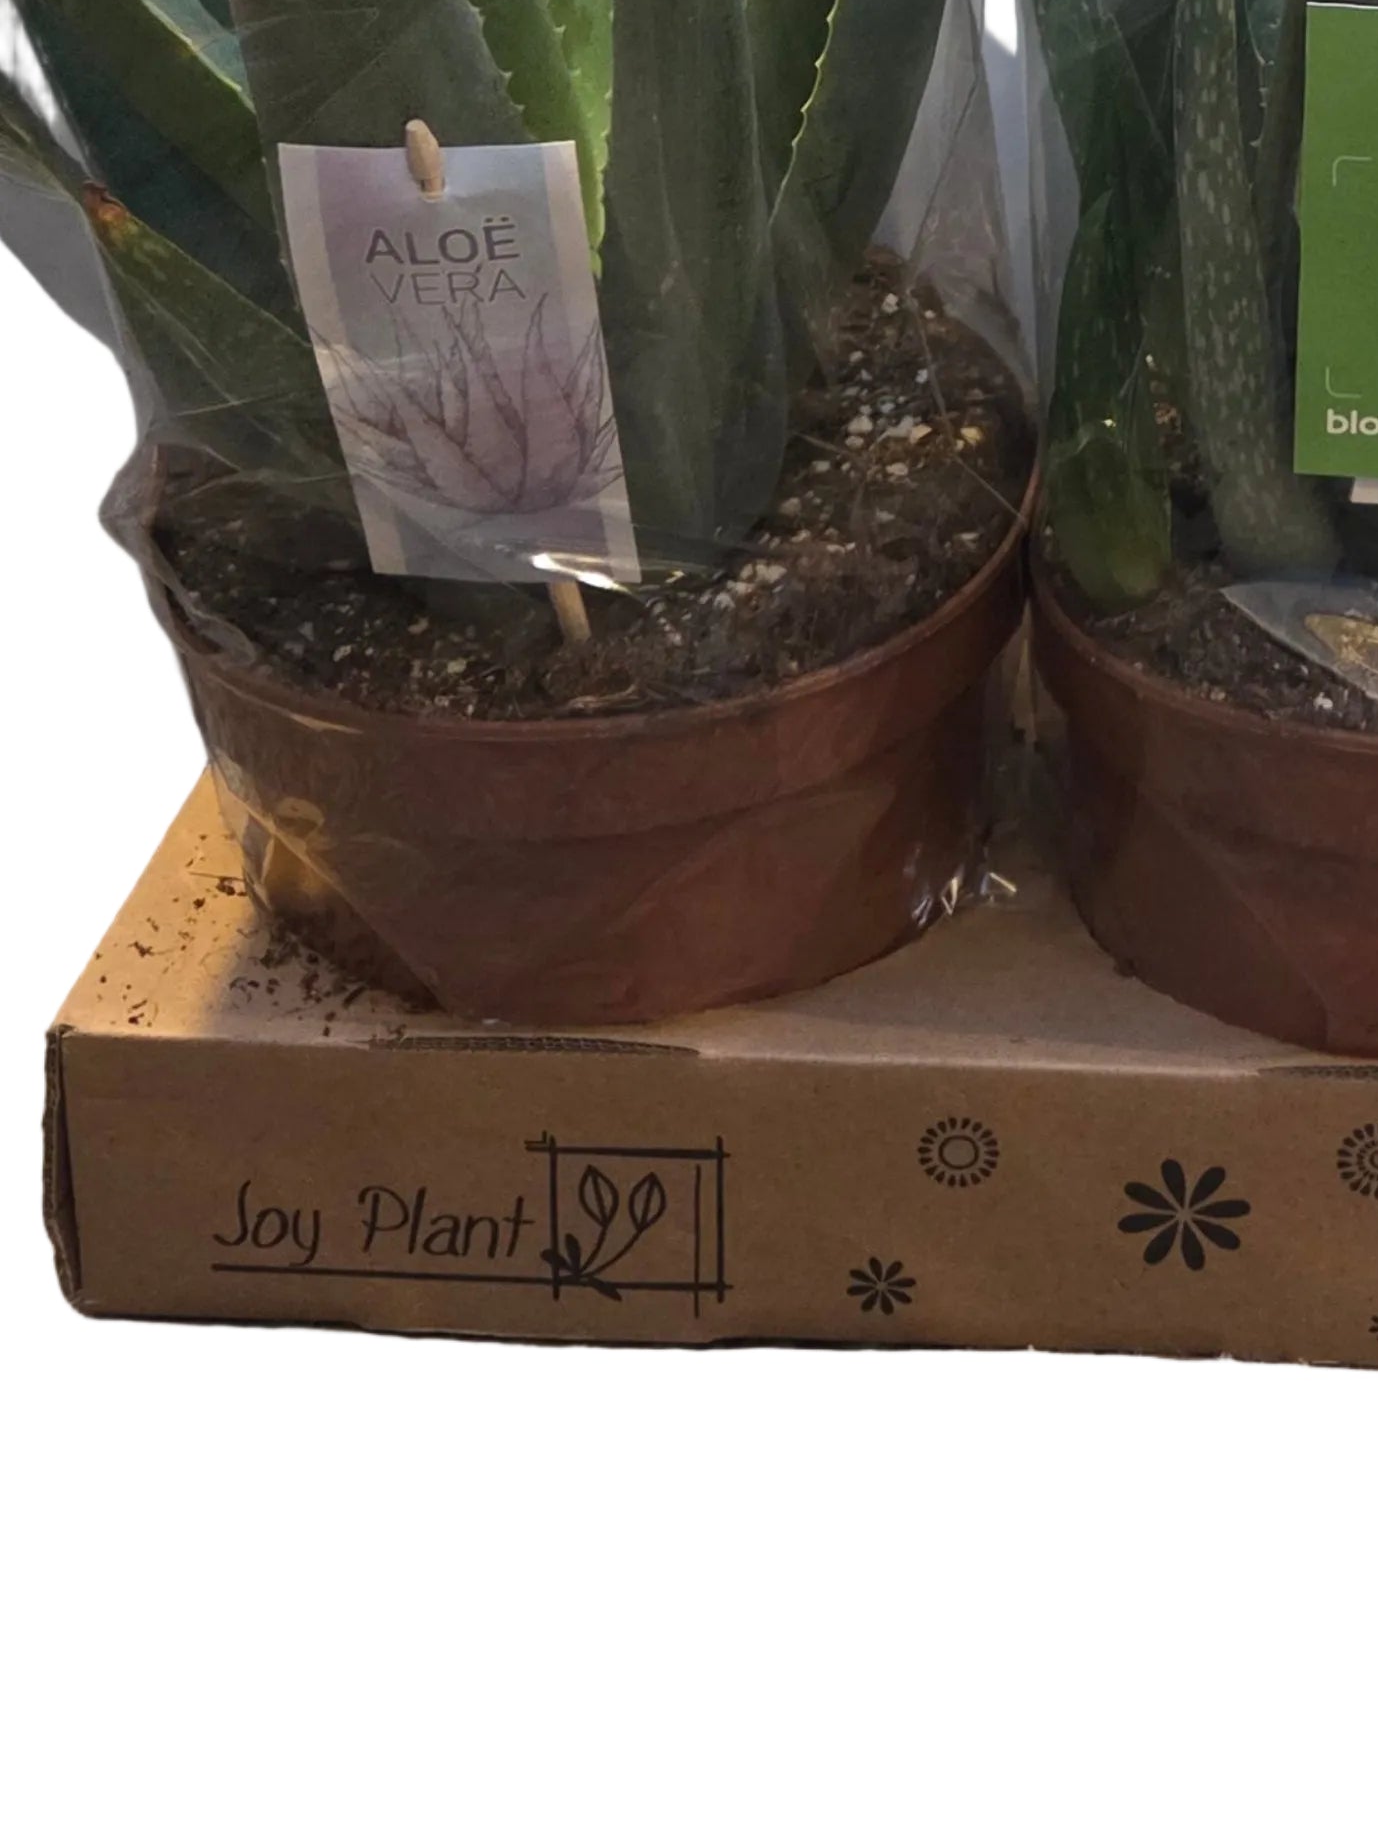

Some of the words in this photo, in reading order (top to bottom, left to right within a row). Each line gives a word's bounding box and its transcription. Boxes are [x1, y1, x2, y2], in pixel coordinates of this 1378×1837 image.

[365, 216, 520, 265] ALOË
[369, 268, 526, 306] VERA
[212, 1180, 321, 1267] Joy
[358, 1185, 537, 1259] Plant
